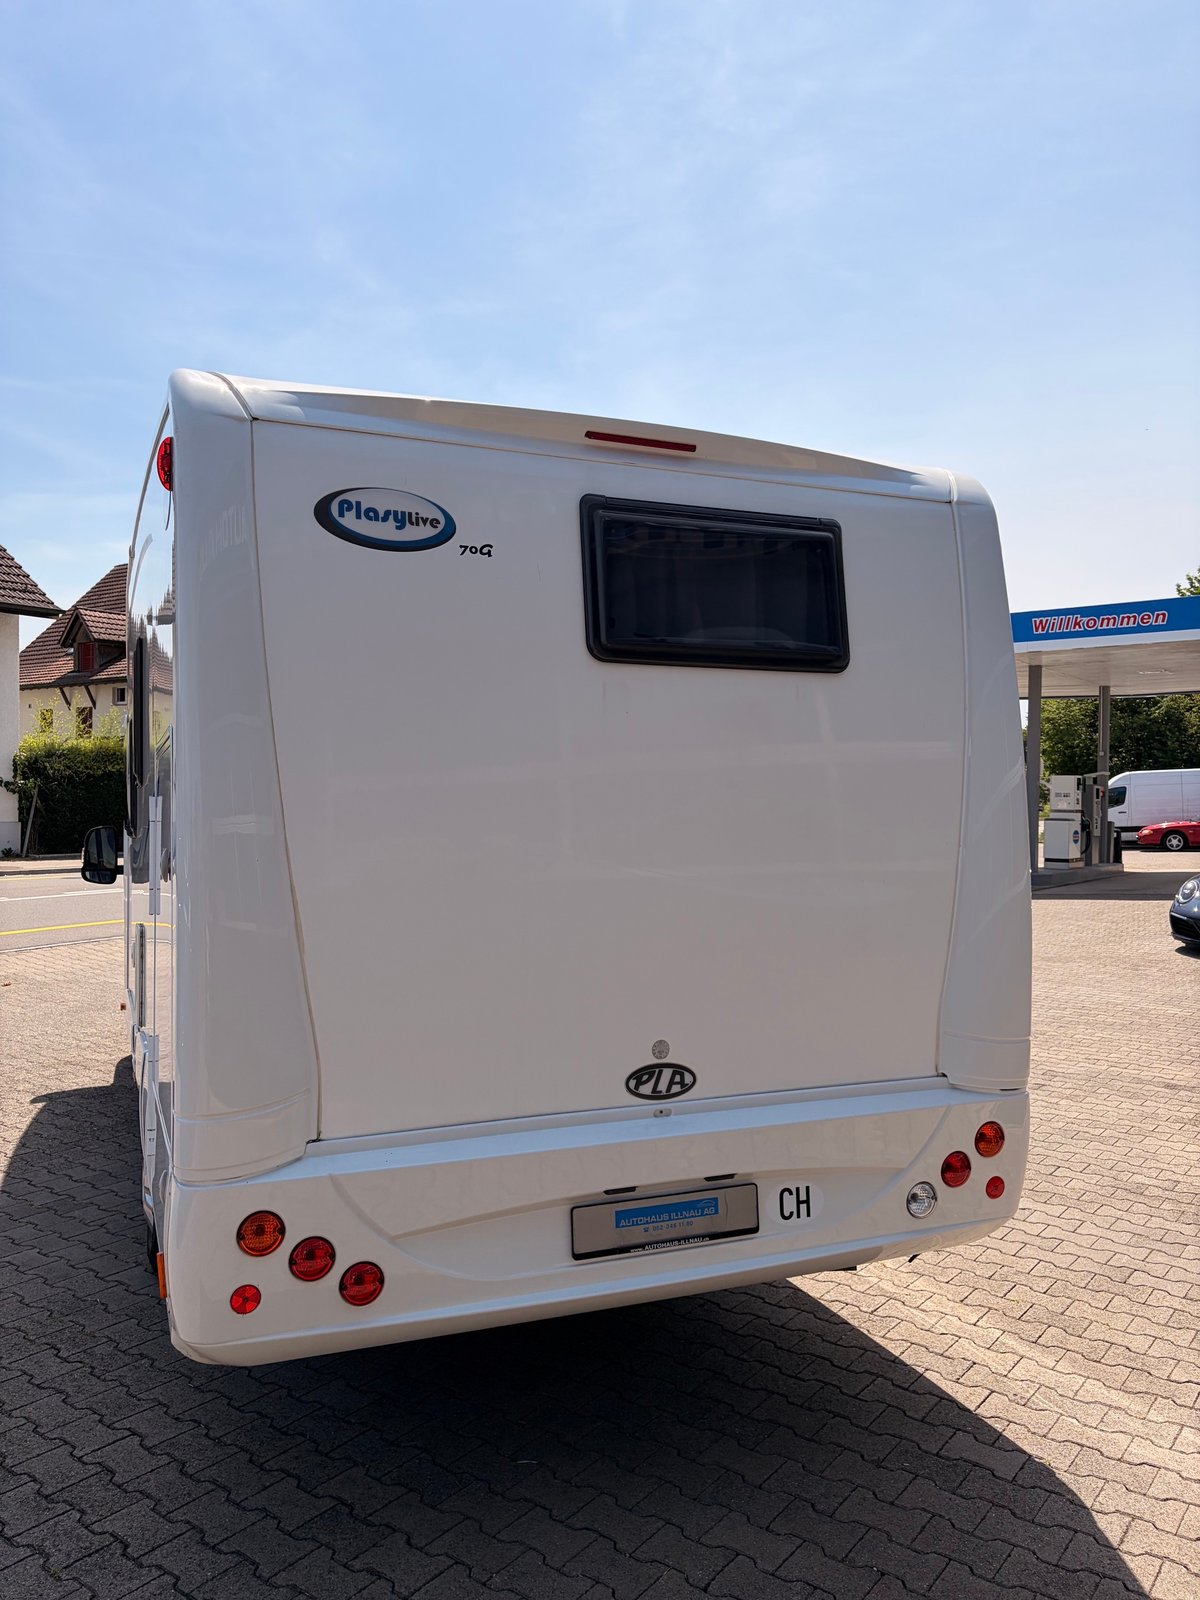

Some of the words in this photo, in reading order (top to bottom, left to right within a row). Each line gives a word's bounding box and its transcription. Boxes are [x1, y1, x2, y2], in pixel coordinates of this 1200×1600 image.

[459, 543, 494, 558] 70G
[1032, 610, 1168, 634] Willkommen
[632, 1068, 690, 1095] PLA
[779, 1186, 811, 1220] CH
[620, 1212, 669, 1227] AUTOHAUS
[671, 1209, 701, 1221] ILLNAU
[704, 1206, 715, 1216] AG
